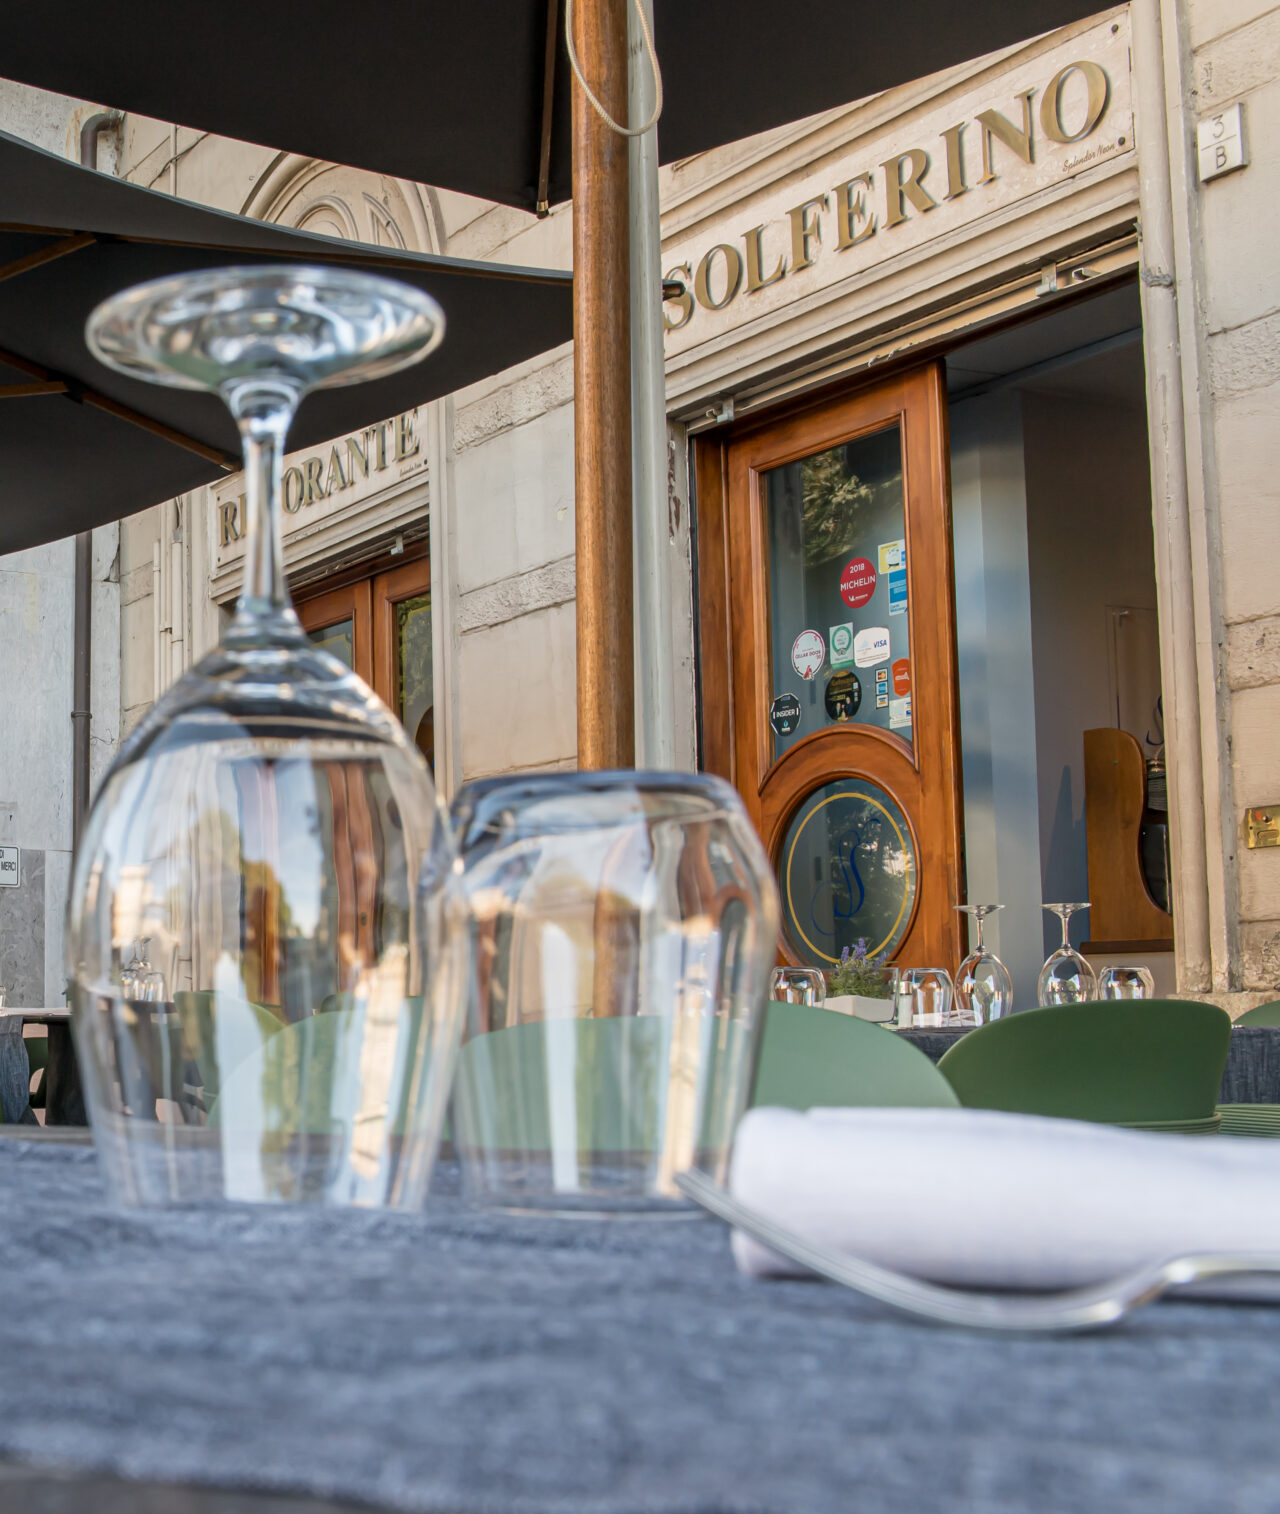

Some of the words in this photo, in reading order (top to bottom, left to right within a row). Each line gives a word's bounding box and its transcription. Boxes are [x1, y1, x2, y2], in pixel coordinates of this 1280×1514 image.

[1212, 114, 1224, 139] 3
[1062, 149, 1096, 174] Splendor
[1097, 143, 1115, 158] Neon
[1216, 146, 1228, 169] B
[663, 60, 1108, 331] SOLFERINO
[219, 408, 420, 547] RIORANTE
[849, 563, 865, 574] 2018
[840, 575, 876, 592] MICHELIN
[873, 639, 887, 648] VISA
[0, 849, 5, 859] DI
[1, 862, 16, 871] MERCI
